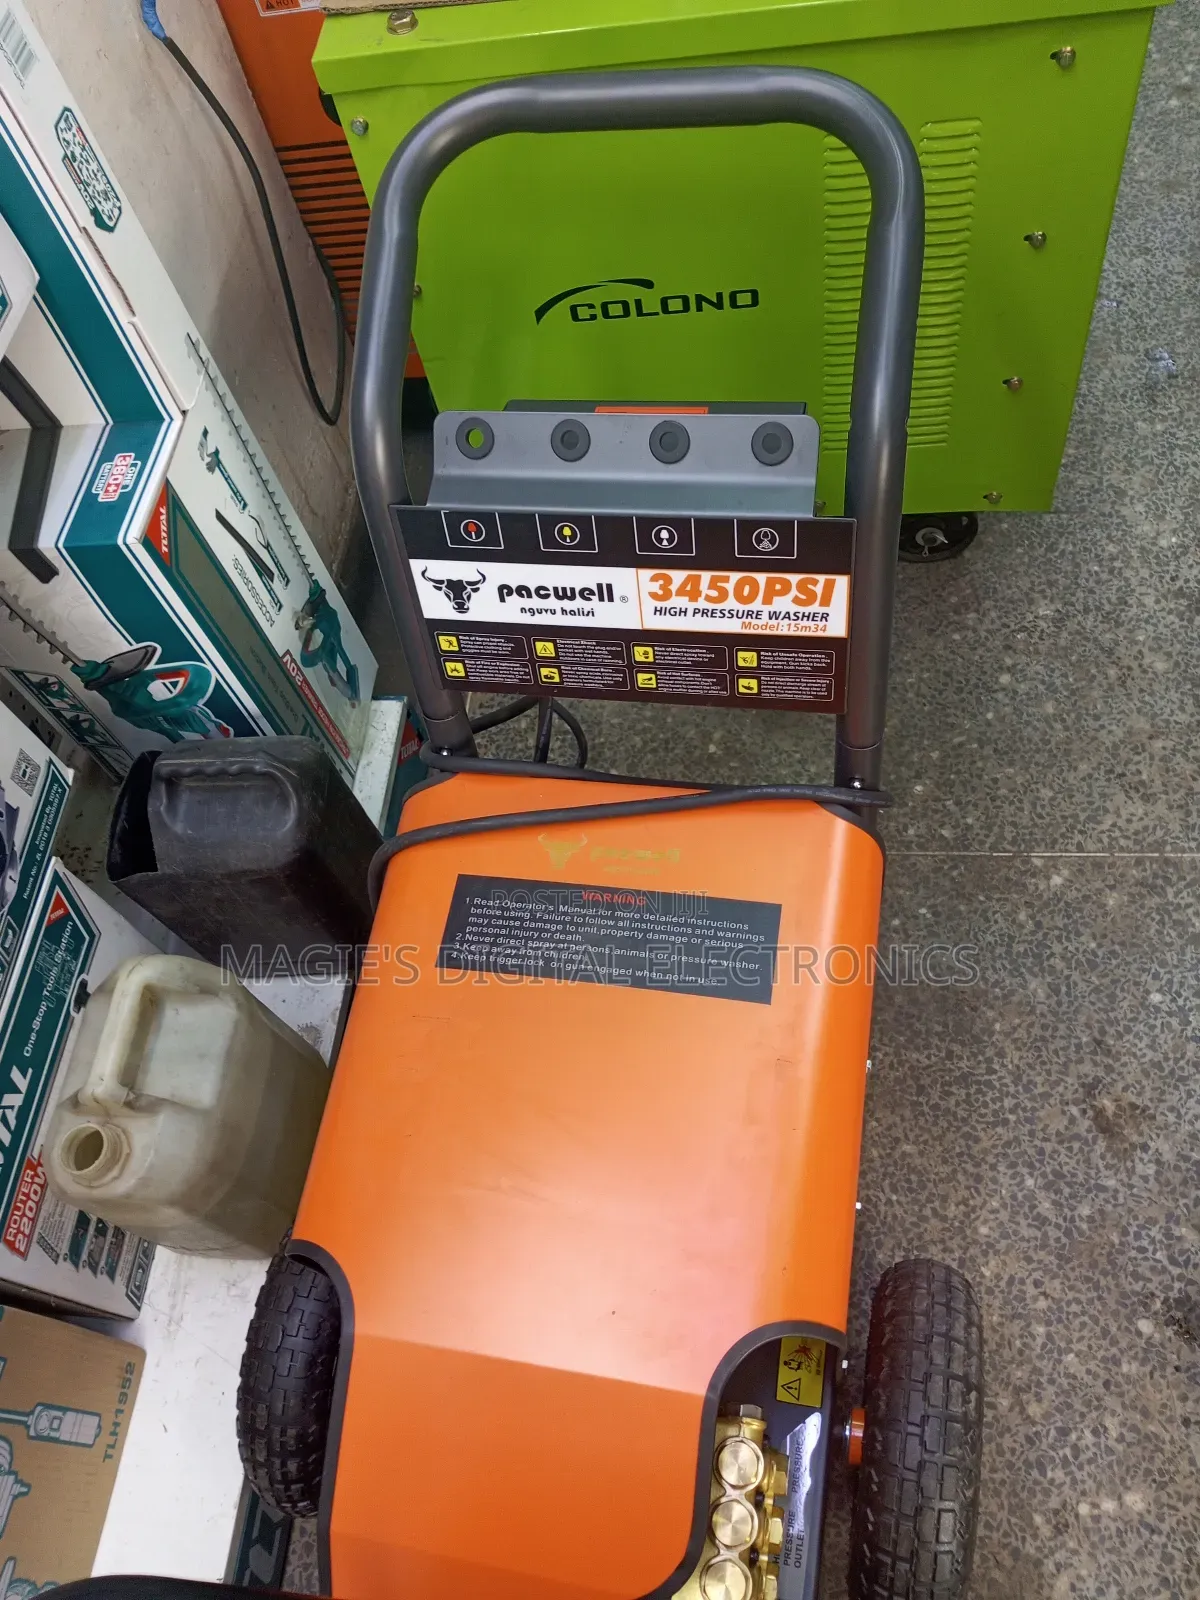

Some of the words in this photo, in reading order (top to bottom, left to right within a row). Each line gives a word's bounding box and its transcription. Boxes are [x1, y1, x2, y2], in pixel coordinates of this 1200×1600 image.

[569, 289, 760, 323] COLONO
[160, 505, 169, 554] TOTAL
[496, 582, 615, 604] pacwell
[647, 572, 837, 608] 3450PSI
[519, 607, 557, 618] nguvu
[560, 607, 596, 618] halisi
[652, 605, 689, 617] HIGH
[691, 607, 764, 622] PRESSURE
[766, 610, 831, 623] WASHER
[740, 620, 828, 634] Model:15m34
[282, 653, 304, 686] 20V
[22, 876, 34, 899] Patent
[582, 891, 647, 906] WARNING
[466, 925, 509, 935] personal
[511, 928, 539, 939] injury
[541, 931, 552, 939] or
[468, 916, 488, 925] may
[491, 918, 521, 927] cause
[523, 920, 563, 932] damage
[566, 924, 576, 932] to
[646, 932, 688, 944] damage
[691, 936, 702, 944] or
[704, 938, 744, 949] serious
[471, 907, 502, 916] before
[536, 912, 571, 922] Failure
[585, 915, 615, 926] follow
[617, 920, 630, 928] all
[631, 920, 692, 934] instructions
[694, 927, 714, 936] and
[716, 930, 765, 943] warnings
[559, 905, 599, 915] Manual
[615, 911, 640, 919] more
[643, 912, 685, 924] detailed
[687, 918, 749, 930] instructions
[491, 945, 517, 956] away
[518, 946, 542, 956] from
[497, 935, 525, 946] direct
[527, 940, 556, 950] spray
[557, 941, 568, 949] at
[671, 954, 718, 966] pressure
[550, 960, 562, 968] on
[565, 962, 586, 972] gun
[587, 964, 632, 977] engaged
[635, 969, 663, 980] when
[665, 972, 682, 982] not
[685, 974, 696, 982] in
[23, 1000, 48, 1057] One-Stop
[43, 964, 60, 999] Tools
[54, 920, 74, 963] Station
[0, 1065, 33, 1170] TAL
[5, 1169, 34, 1242] ROUTER
[14, 1157, 48, 1253] 2200W
[103, 1361, 136, 1463] TLH1952
[791, 1439, 805, 1493] PRESSURE
[783, 1511, 796, 1567] PRESSURE
[793, 1527, 806, 1569] OUTLET
